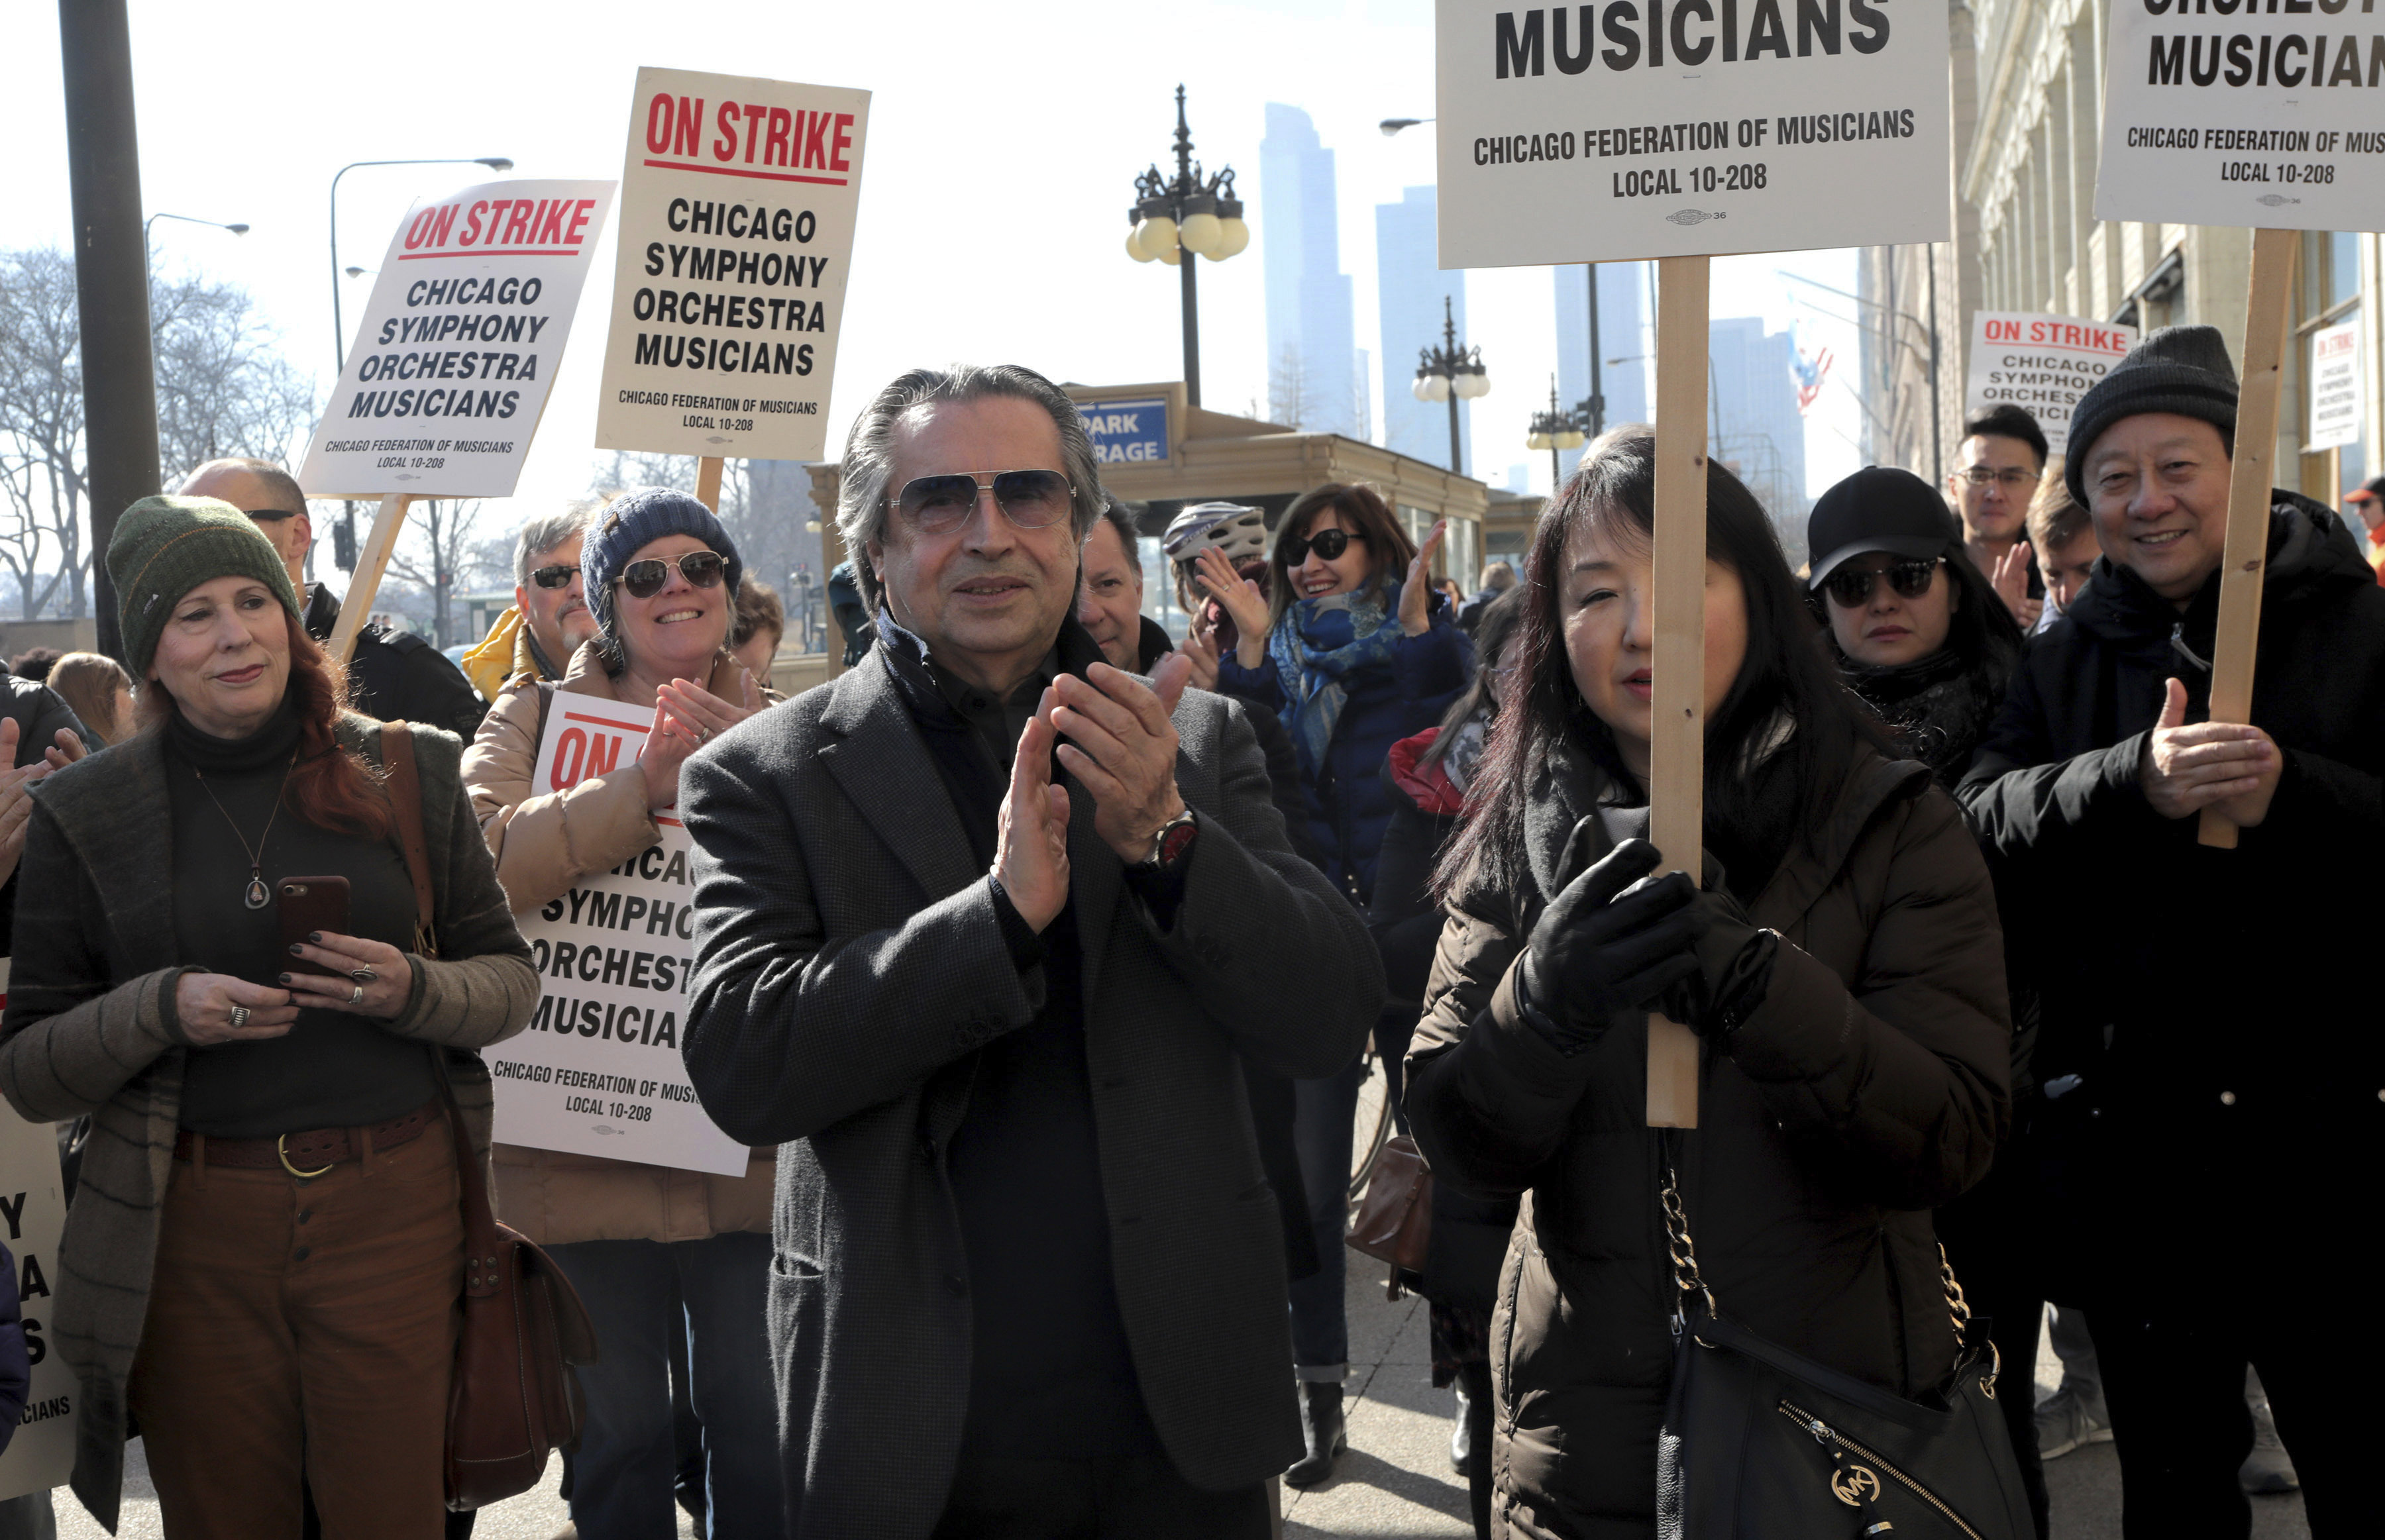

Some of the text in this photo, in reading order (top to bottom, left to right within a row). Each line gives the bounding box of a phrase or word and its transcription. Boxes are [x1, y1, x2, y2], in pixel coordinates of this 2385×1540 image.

[1495, 0, 1890, 79] MUSICIANS
[647, 93, 855, 172] ON STRIKE
[1473, 109, 1915, 165] CHICAGO FEDERATION OF MUSICIANS
[2128, 127, 2198, 149] CHICAGO
[2204, 129, 2310, 152] FEDERATION
[2315, 132, 2339, 152] OF
[1613, 163, 1767, 197] LOCAL 10-208
[2221, 162, 2335, 184] LOCAL 10-208
[405, 199, 596, 250] ON STRIKE
[668, 197, 816, 243] CHICAGO
[645, 242, 829, 288] SYMPHONY
[407, 278, 542, 307] CHICAGO
[633, 287, 825, 333] ORCHESTRA
[378, 315, 549, 345] SYMPHONY
[1985, 320, 2126, 351] ON STRIKE
[358, 352, 537, 382] ORCHESTRA
[635, 333, 814, 376] MUSICIANS
[2003, 355, 2106, 375] CHICAGO
[348, 389, 520, 419] MUSICIANS
[619, 390, 818, 415] CHICAGO FEDERATION OF MUSICIANS
[1984, 388, 2084, 405] ORCHES
[683, 415, 753, 431] LOCAL 10-208
[325, 439, 513, 454] CHICAGO FEDERATION OF MUSICIANS
[377, 457, 445, 469] LOCAL 10-208
[551, 727, 622, 792] ON
[531, 995, 676, 1049] MUSICIA
[494, 1060, 551, 1084] CHICAGO
[555, 1068, 636, 1095] FEDERATION
[639, 1080, 658, 1098] OF
[566, 1096, 653, 1121] LOCAL 10-208
[17, 1396, 70, 1425] CIANS
